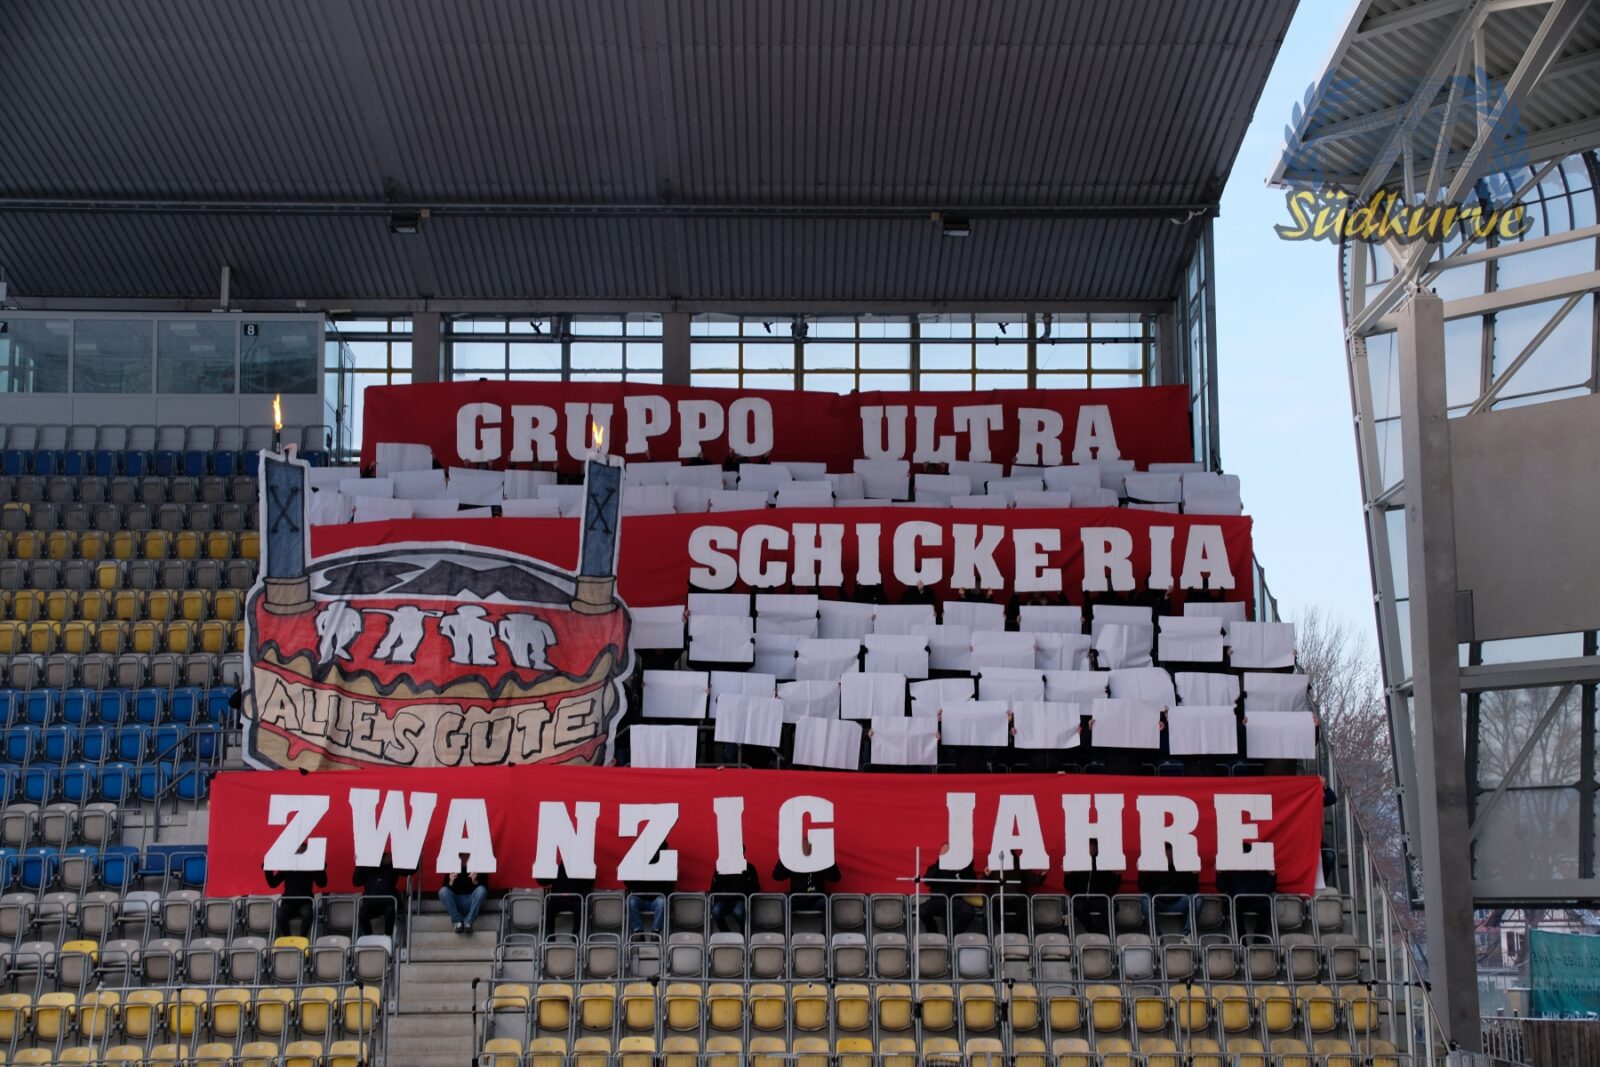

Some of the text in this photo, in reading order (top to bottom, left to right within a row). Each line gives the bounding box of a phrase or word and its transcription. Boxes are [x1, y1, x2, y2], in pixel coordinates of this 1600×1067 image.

[456, 396, 1121, 467] GRUPPO ULTRA
[687, 521, 1236, 592] SCHICKERIA
[260, 678, 599, 766] ALLES GUTE
[263, 788, 1276, 882] ZWANZIG JAHRE
